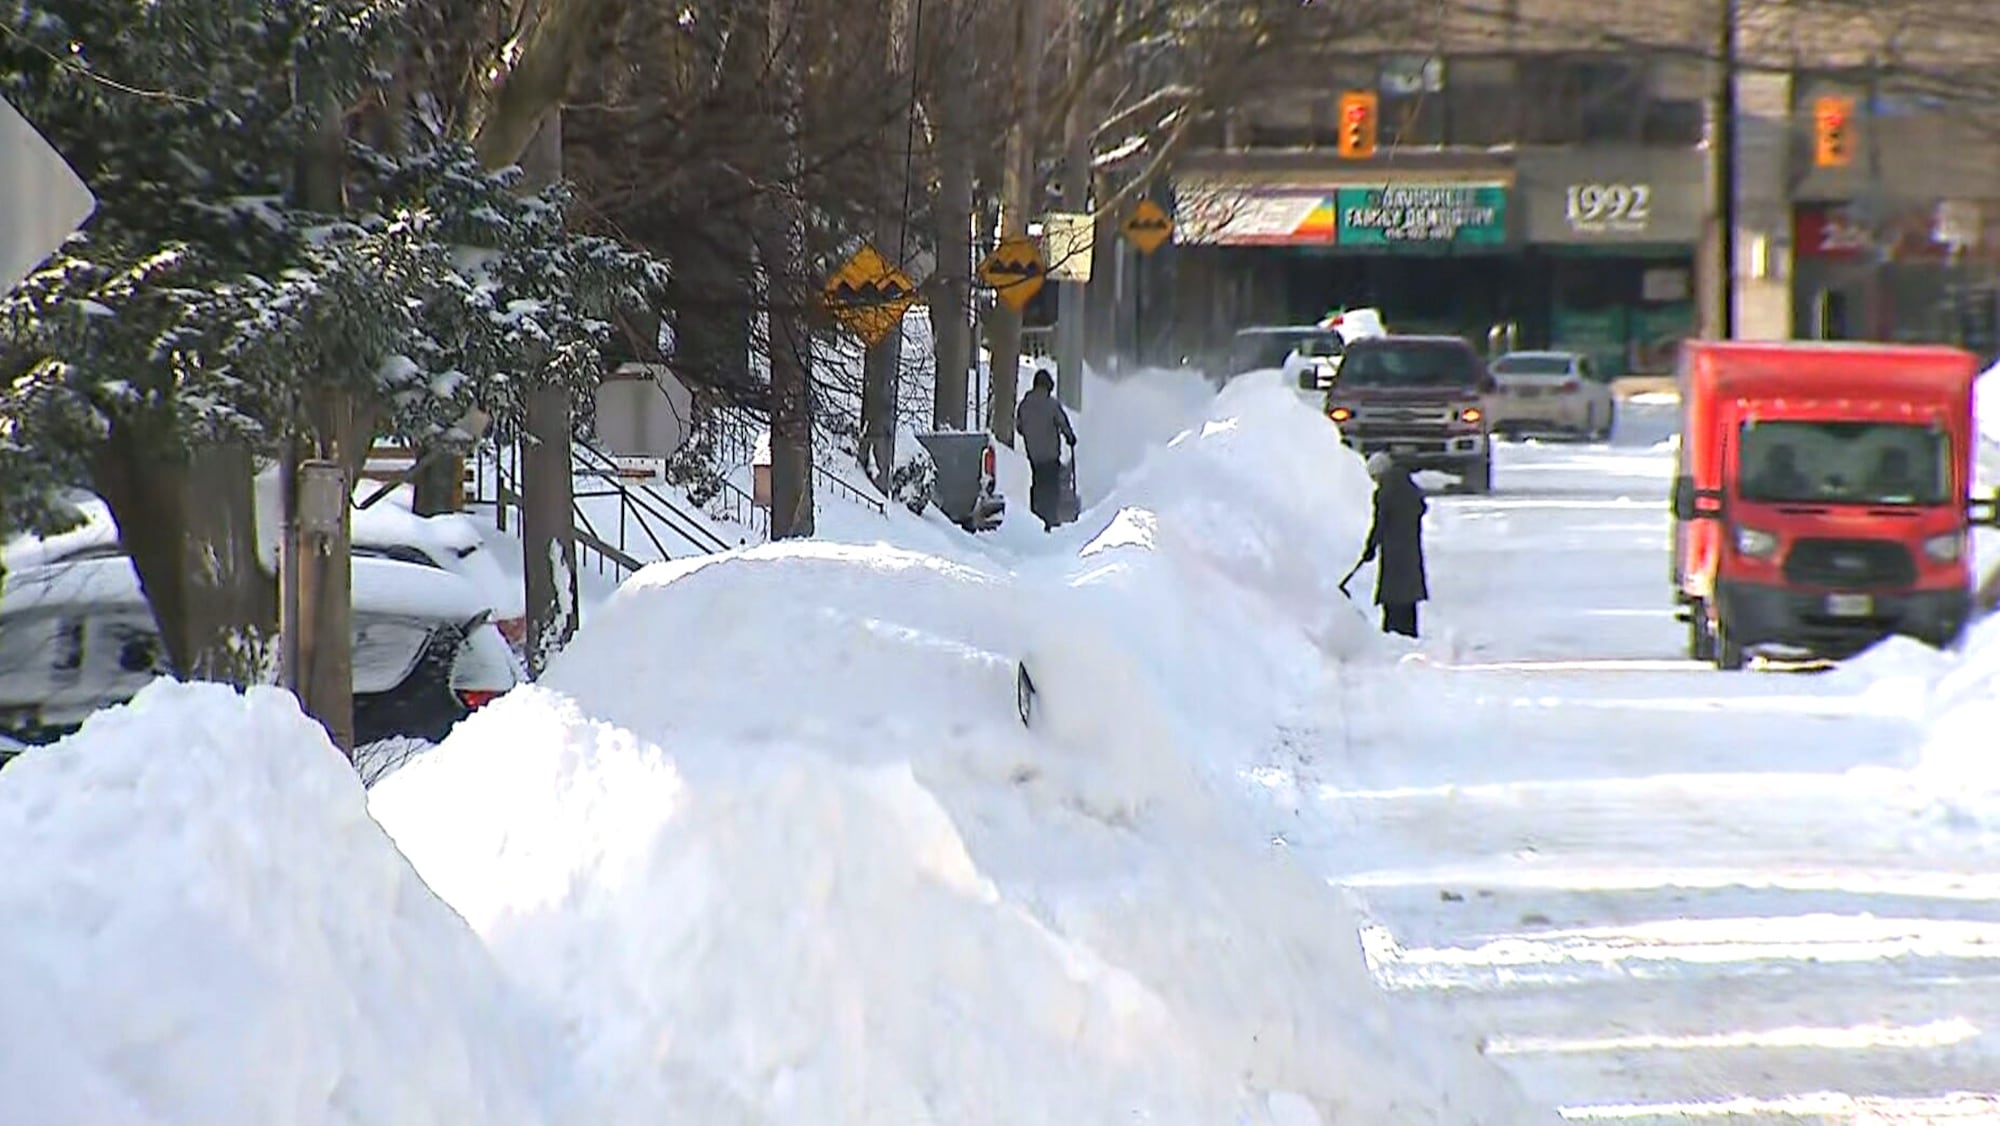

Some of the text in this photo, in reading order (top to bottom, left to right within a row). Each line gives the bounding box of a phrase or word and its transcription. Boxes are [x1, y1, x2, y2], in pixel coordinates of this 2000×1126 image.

[1565, 184, 1649, 218] 1992
[1345, 207, 1494, 226] FAMILY DENTISTRY
